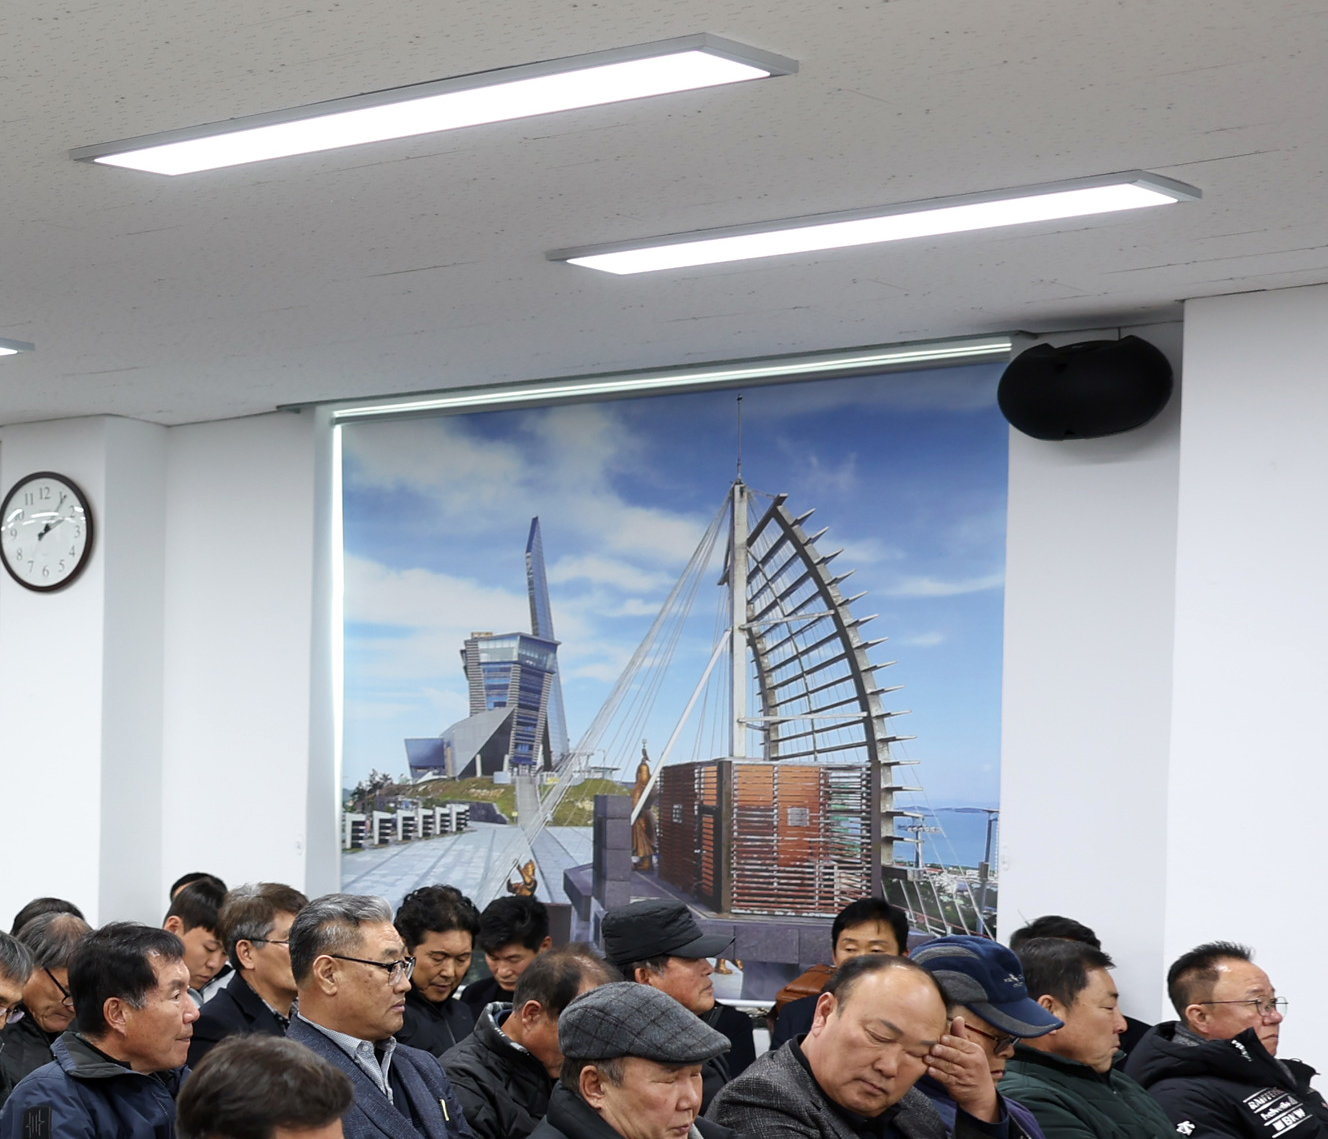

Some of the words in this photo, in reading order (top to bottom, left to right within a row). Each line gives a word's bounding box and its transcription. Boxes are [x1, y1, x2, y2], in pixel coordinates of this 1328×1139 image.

[25, 493, 34, 506] 11
[39, 487, 51, 500] 12
[69, 505, 76, 518] 2
[10, 529, 17, 540] 9
[74, 525, 81, 538] 3
[16, 548, 23, 561] 8
[69, 545, 76, 558] 4
[27, 560, 34, 573] 7
[42, 565, 49, 577] 6
[58, 559, 65, 572] 5
[1282, 1107, 1306, 1126] BKW
